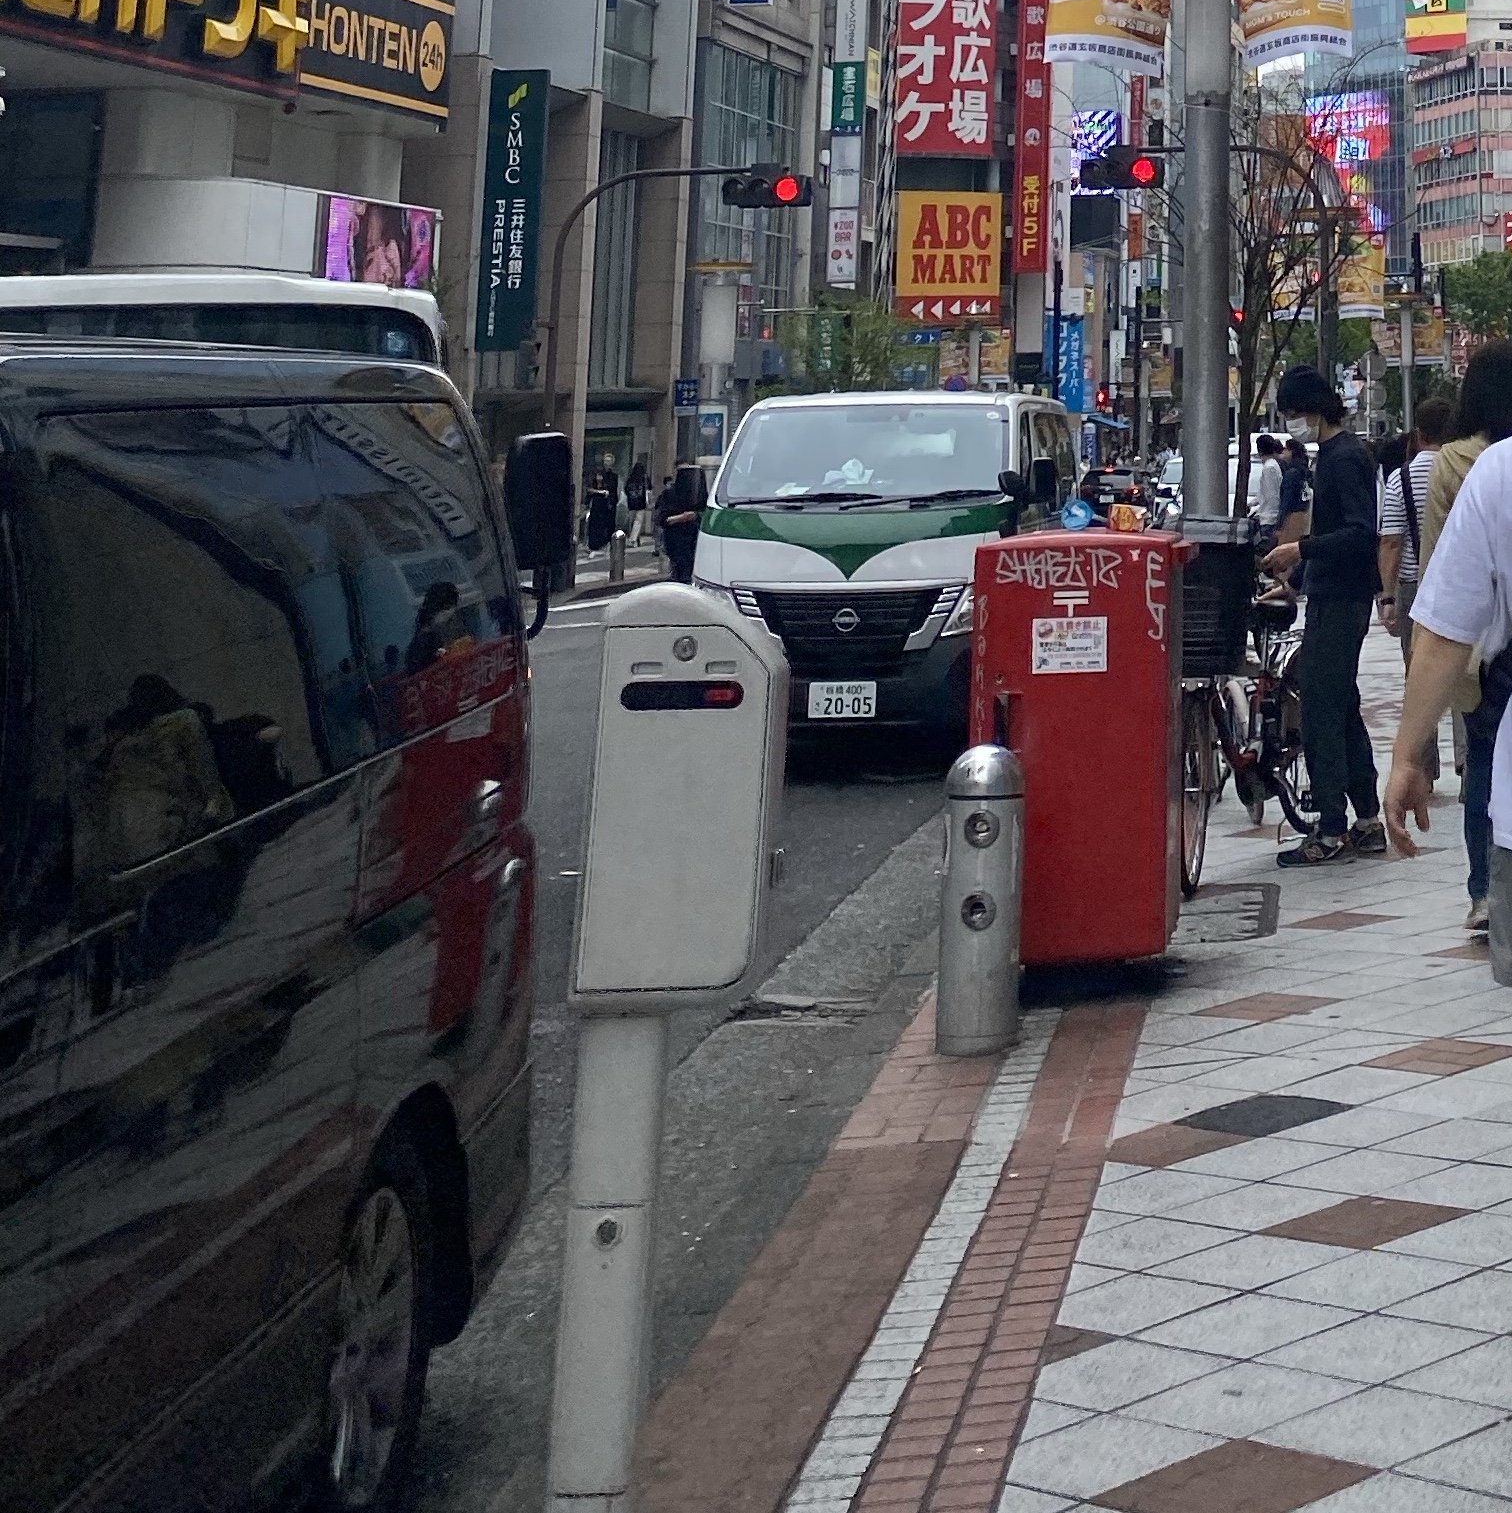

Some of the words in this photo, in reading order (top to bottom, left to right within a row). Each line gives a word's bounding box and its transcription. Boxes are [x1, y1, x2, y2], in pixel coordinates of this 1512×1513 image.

[421, 41, 444, 71] 24h
[504, 112, 524, 184] SMBC
[912, 203, 992, 250] ABC
[506, 198, 527, 289] 三井住友銀行
[911, 254, 992, 284] MART
[845, 684, 862, 695] 400
[823, 696, 873, 716] 20-05
